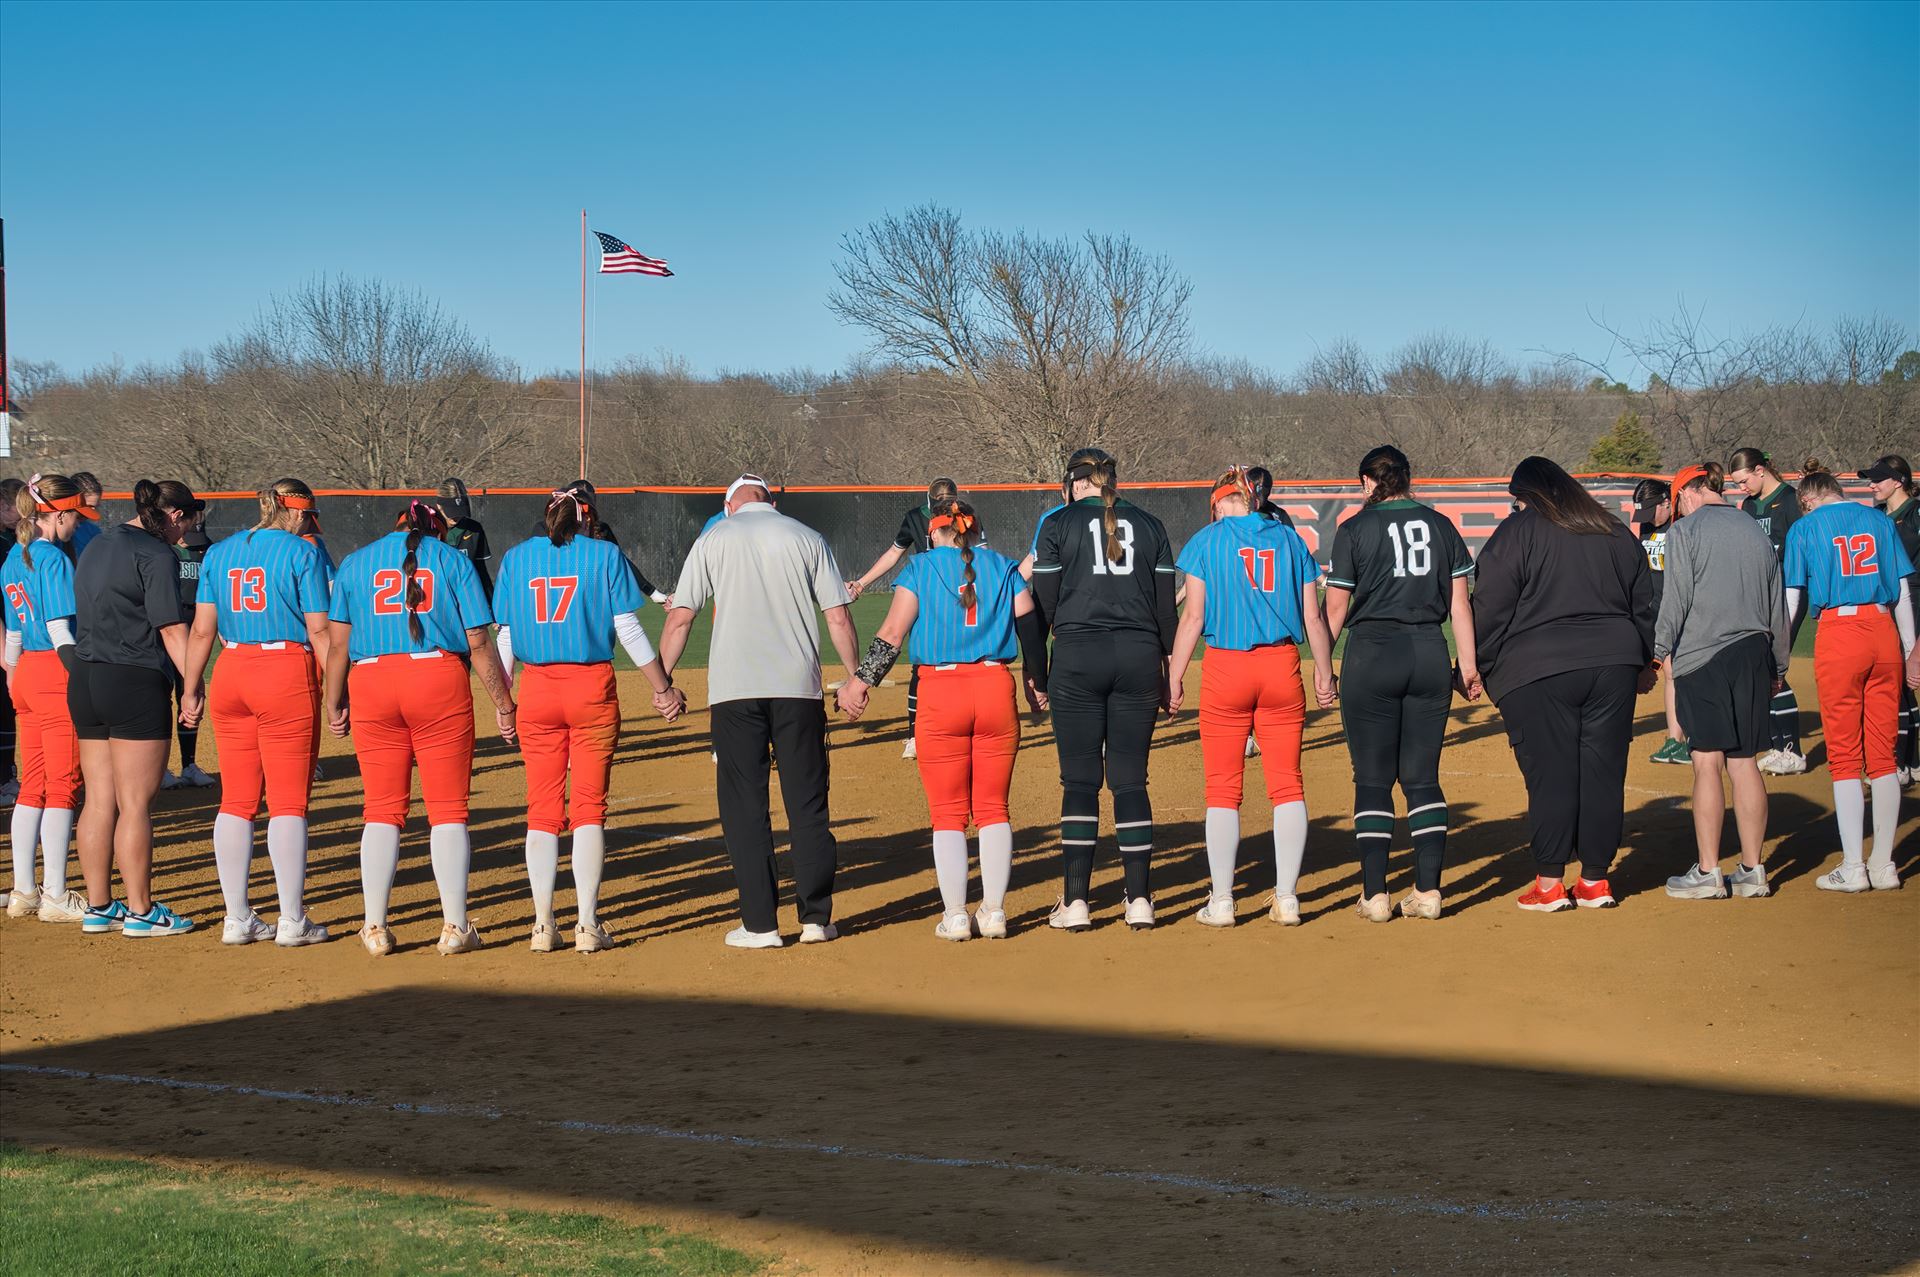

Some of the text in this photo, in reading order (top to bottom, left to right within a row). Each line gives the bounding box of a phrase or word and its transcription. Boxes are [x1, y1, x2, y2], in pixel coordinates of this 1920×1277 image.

[1238, 546, 1276, 592] 11
[1387, 519, 1431, 577] 18
[1832, 533, 1879, 576] 12
[5, 581, 35, 623] 21
[228, 567, 267, 612] 13
[374, 568, 435, 615] 20
[528, 575, 579, 624] 17
